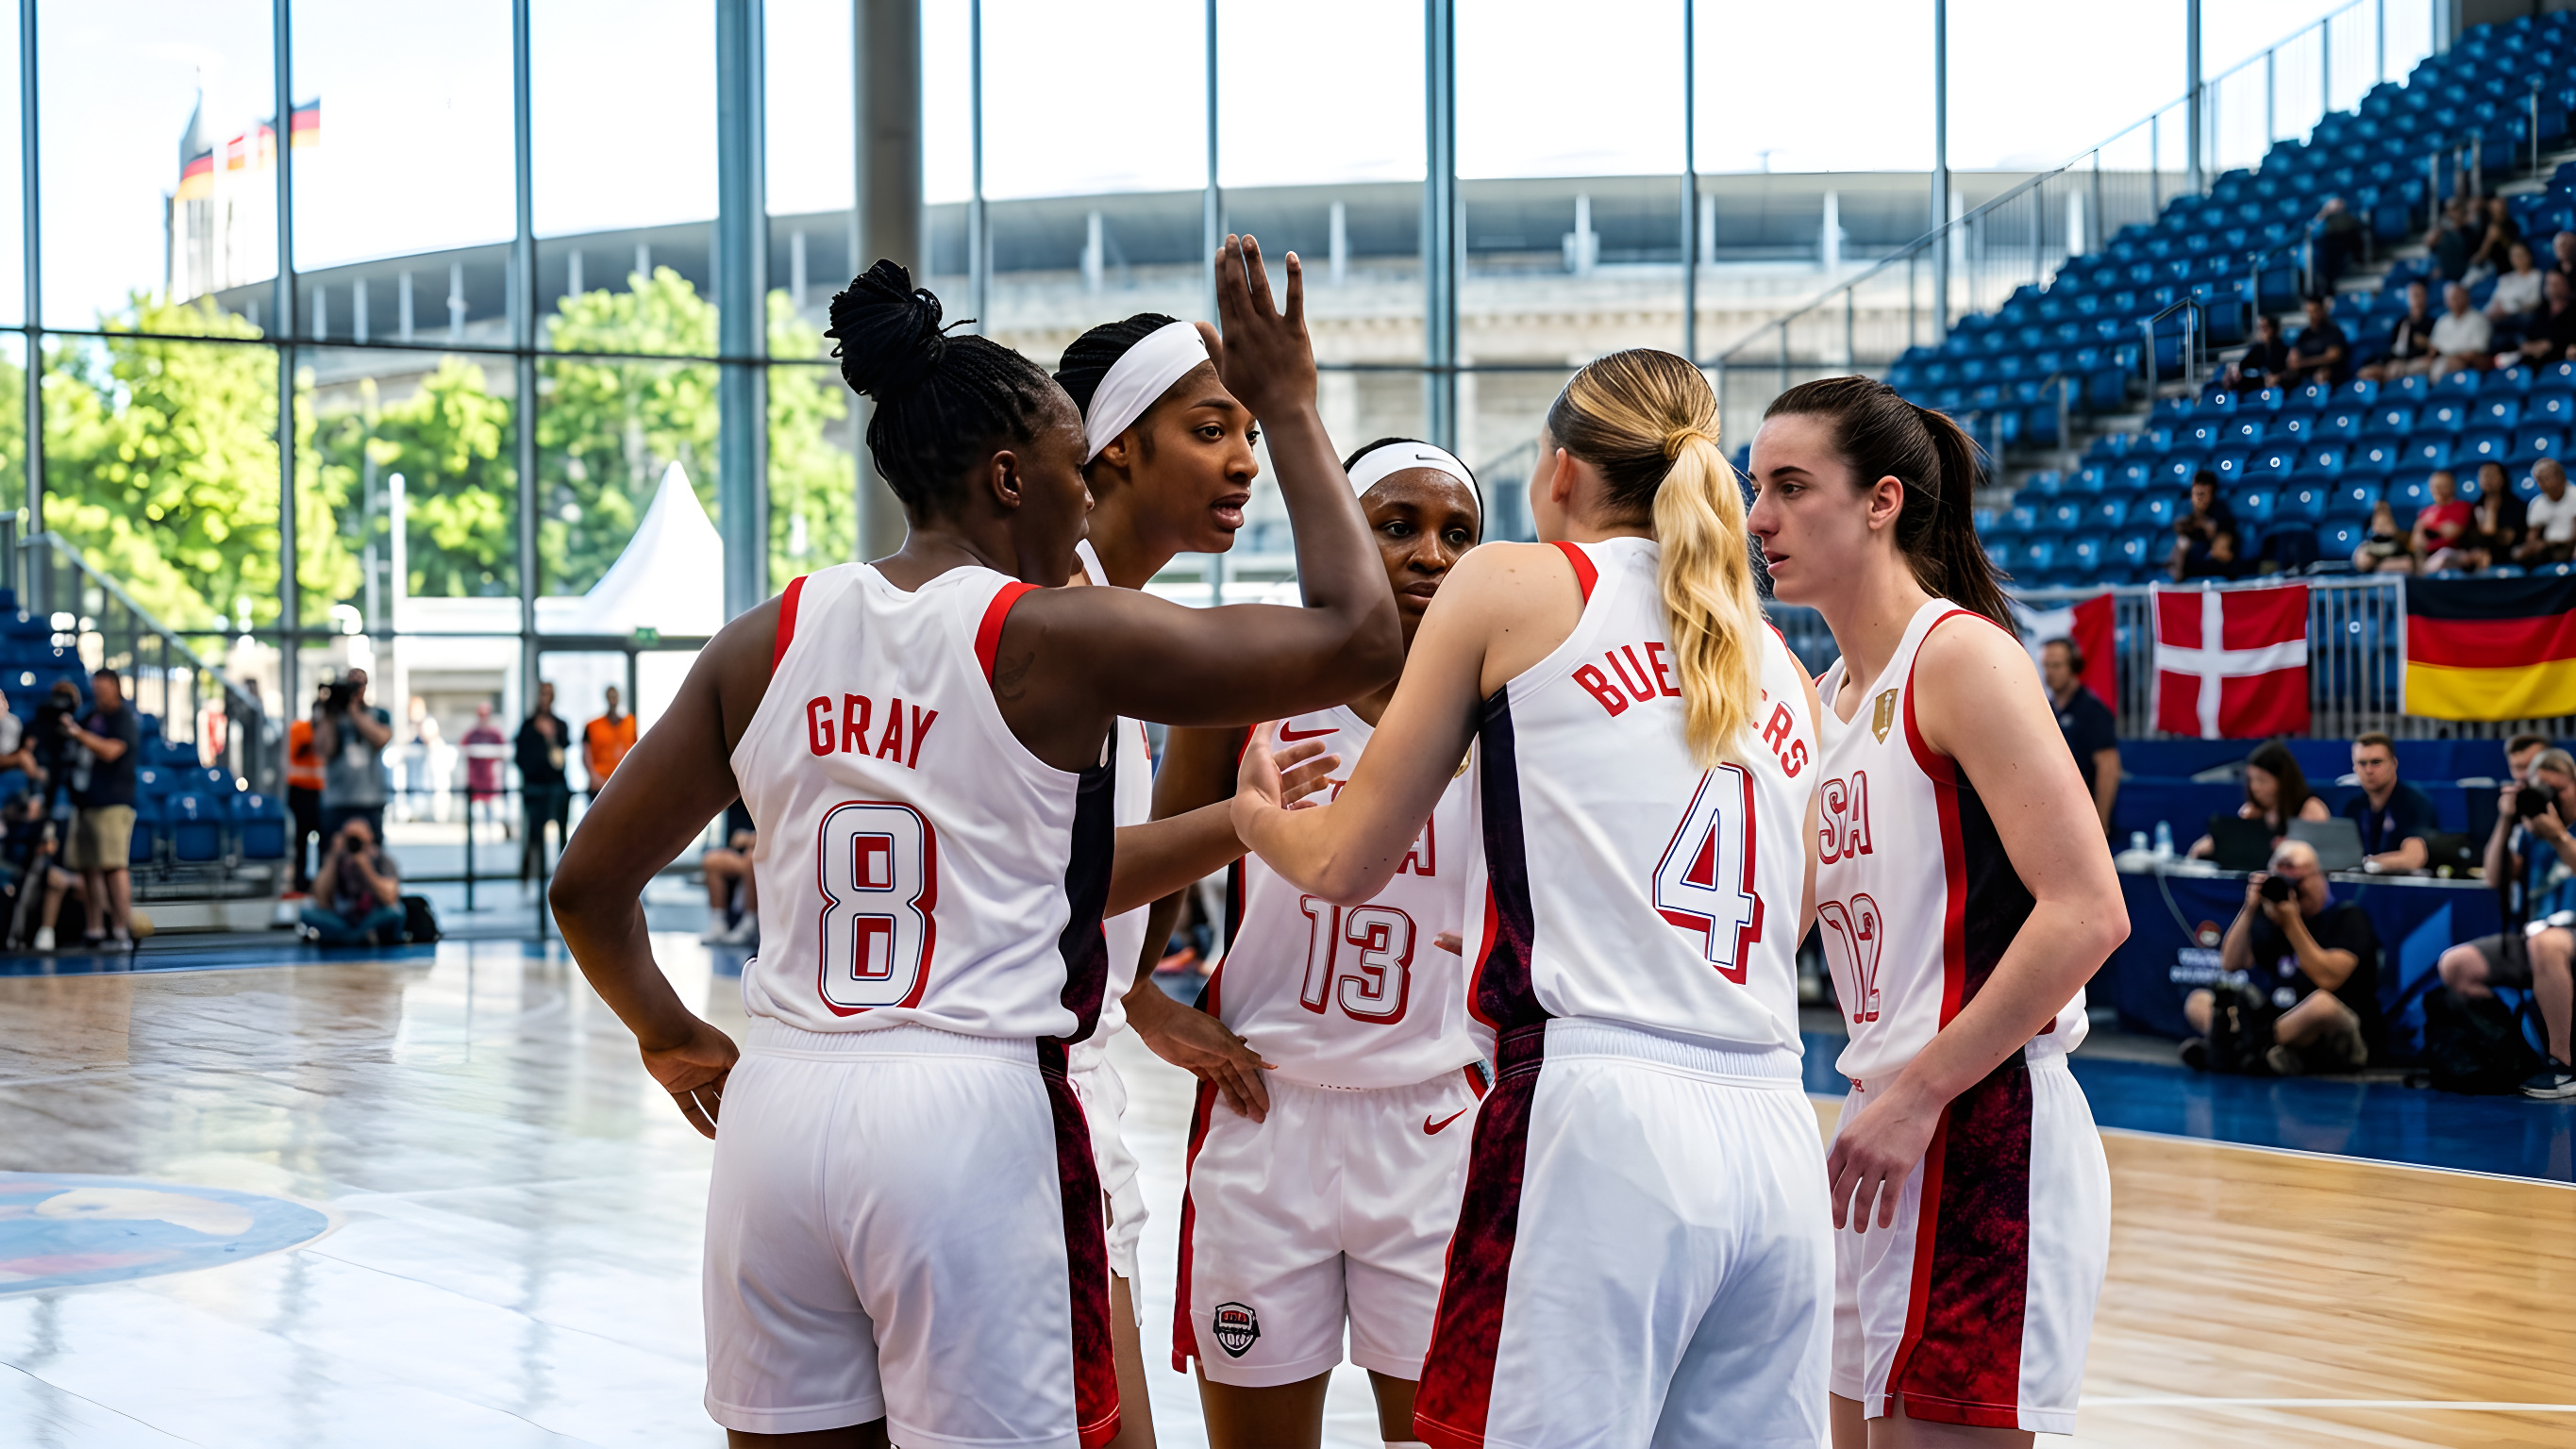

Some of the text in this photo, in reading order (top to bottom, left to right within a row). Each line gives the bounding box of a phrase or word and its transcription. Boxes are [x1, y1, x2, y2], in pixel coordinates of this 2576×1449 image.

[806, 692, 939, 771] GRAY
[1571, 641, 1809, 778] BUERS
[1652, 761, 1765, 985] 4
[1817, 770, 1873, 865] SA
[817, 800, 937, 1017] 8
[1300, 893, 1416, 1025] 13
